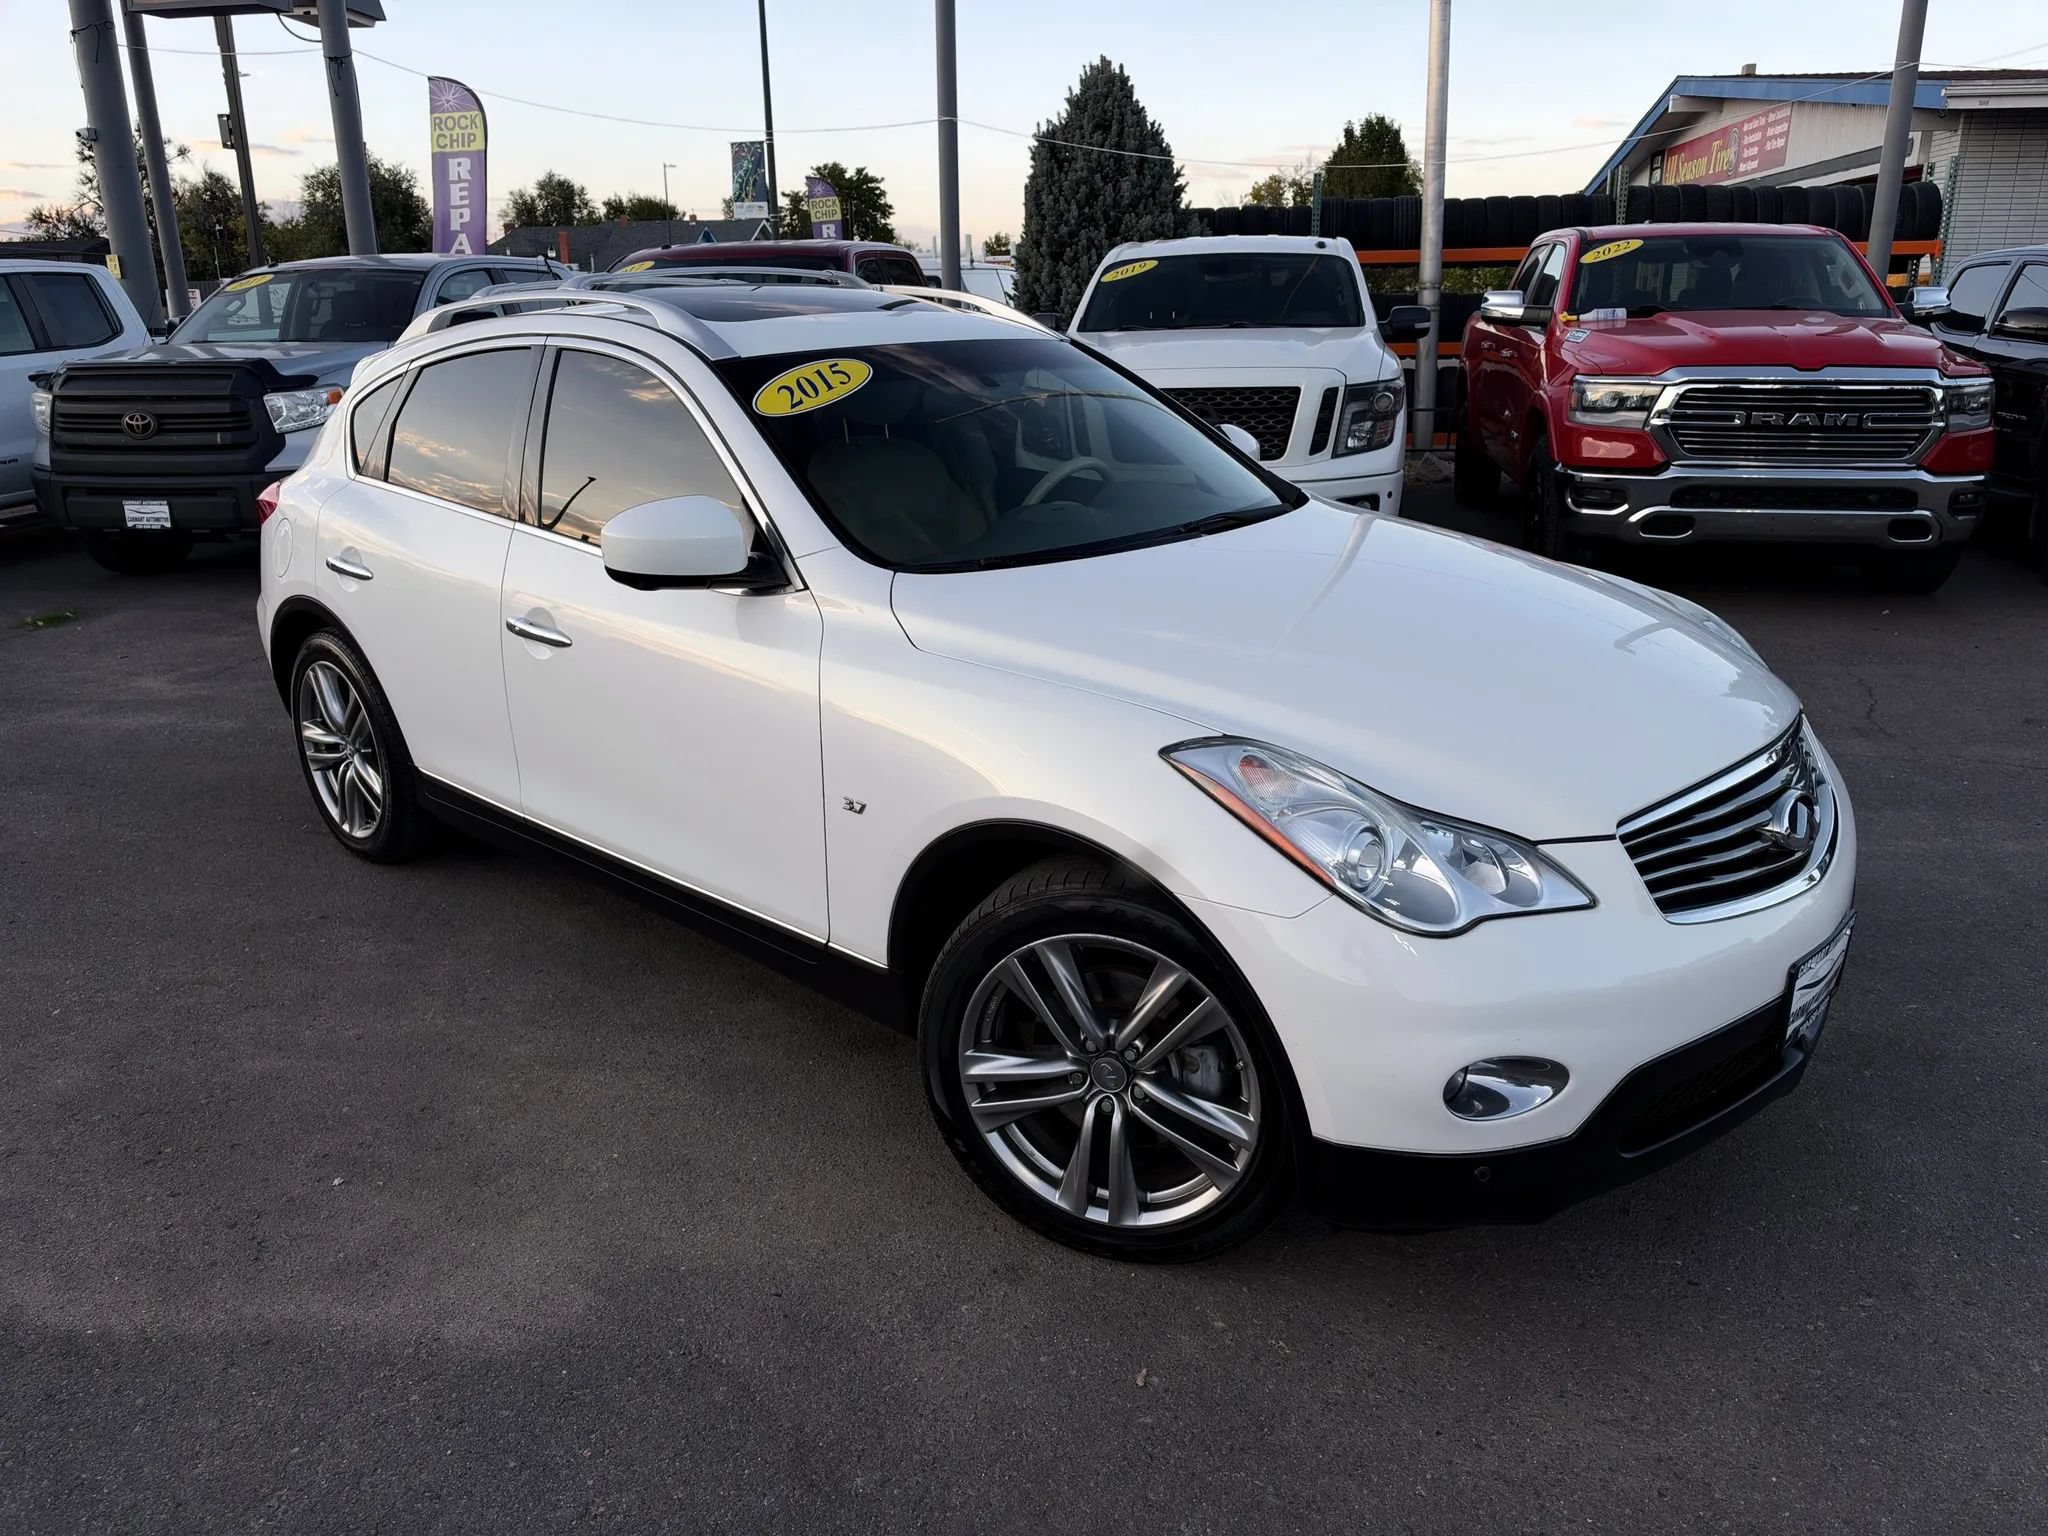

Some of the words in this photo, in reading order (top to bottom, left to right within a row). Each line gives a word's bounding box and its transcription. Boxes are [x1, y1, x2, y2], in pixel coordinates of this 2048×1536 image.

[433, 114, 480, 132] ROCK
[436, 133, 477, 149] CHIP
[1664, 154, 1678, 185] All
[1678, 152, 1708, 183] Season
[1709, 139, 1732, 174] Tire
[811, 198, 839, 210] ROCK
[814, 209, 838, 220] CHIP
[1593, 241, 1632, 260] 2022
[1111, 262, 1147, 280] 2019
[777, 362, 852, 410] 2015
[1750, 411, 1860, 426] RAM
